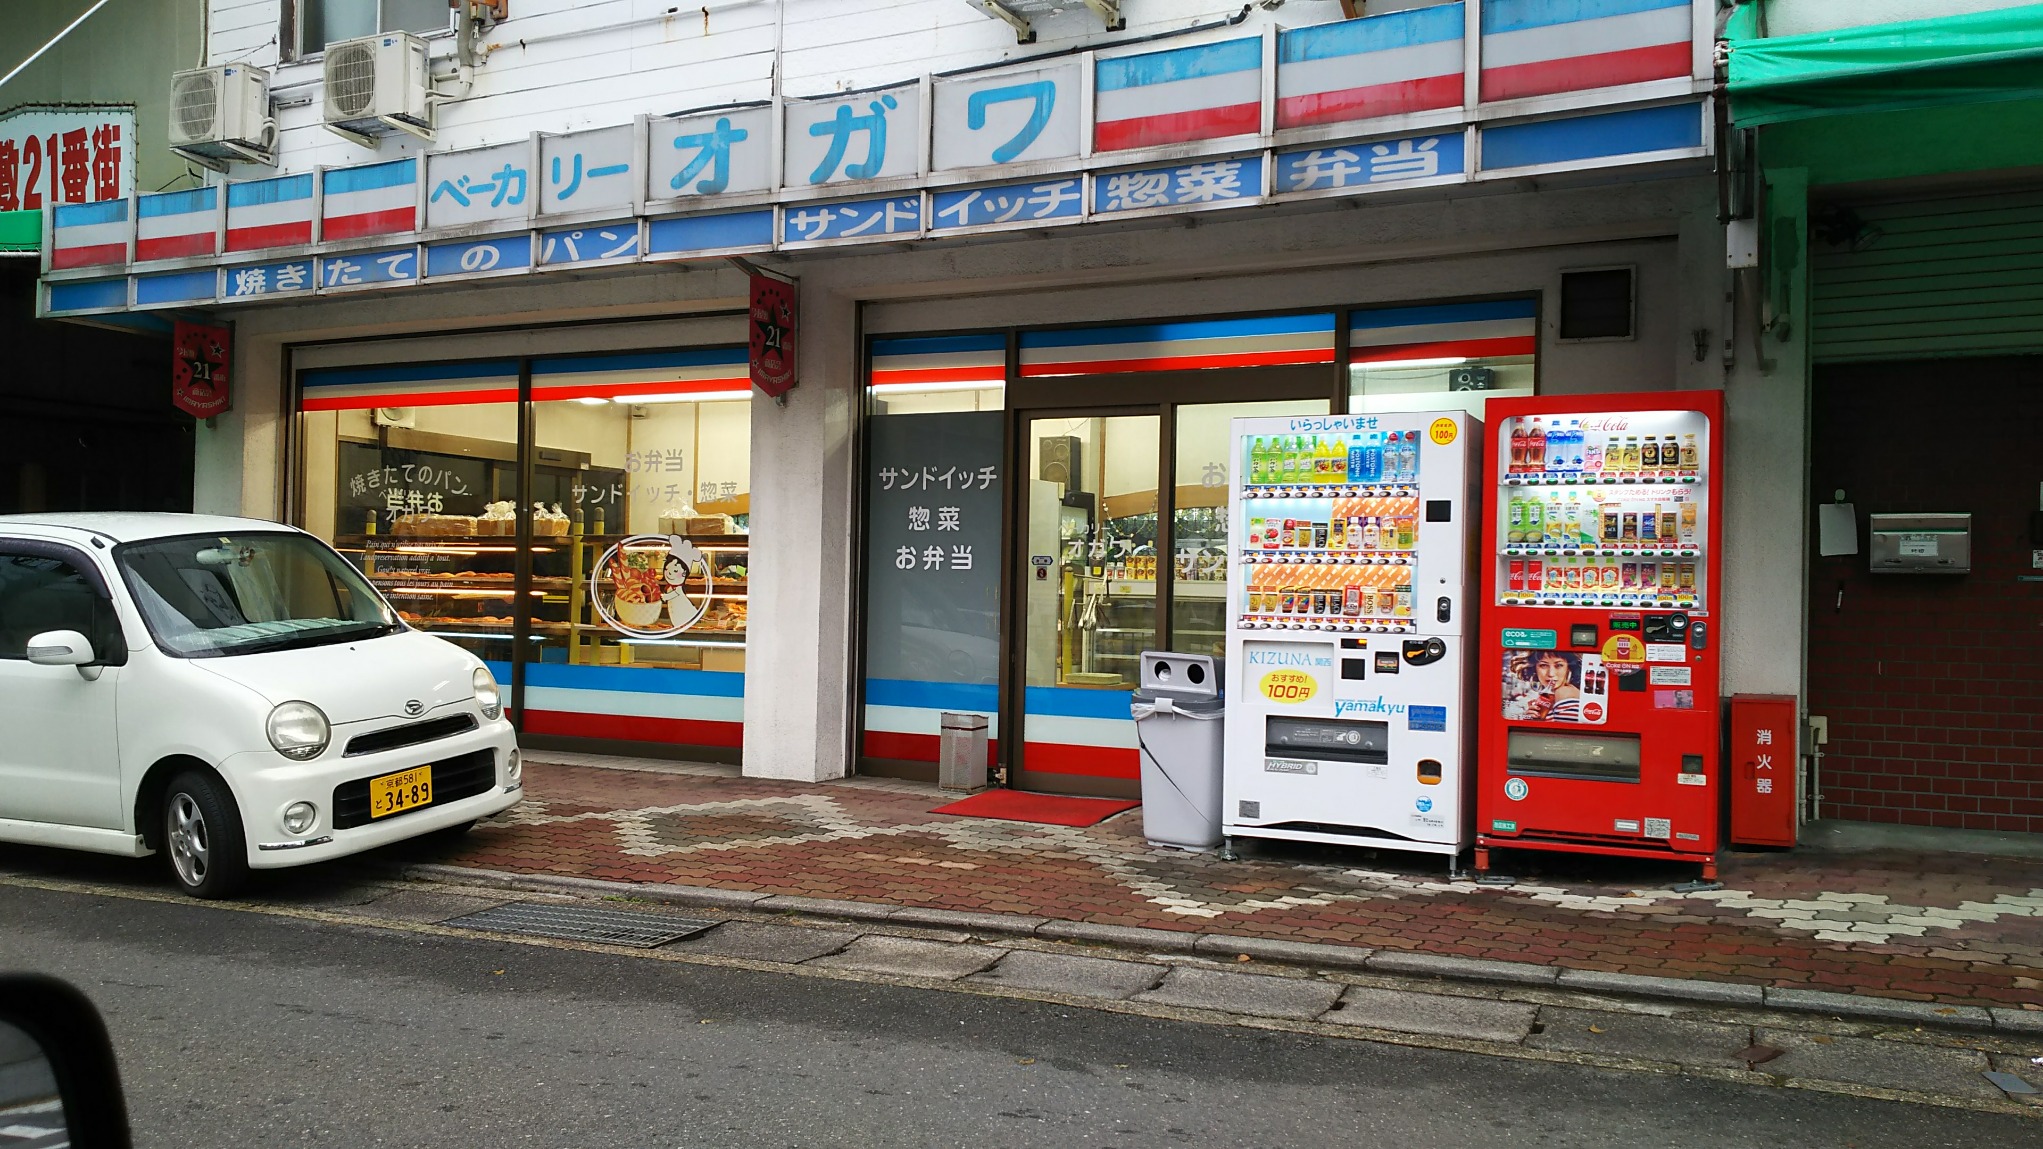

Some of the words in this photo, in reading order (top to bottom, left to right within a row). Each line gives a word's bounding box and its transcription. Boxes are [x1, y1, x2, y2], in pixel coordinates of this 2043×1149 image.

[430, 153, 630, 208] ベーカリー
[670, 79, 1056, 195] オガワ
[236, 231, 638, 296] 焼きたてのパン
[790, 180, 1080, 240] サンドイッチ
[1106, 161, 1242, 211] 惣菜
[1291, 138, 1439, 190] 弁当
[766, 325, 781, 348] 21
[193, 361, 211, 380] 21
[1290, 416, 1378, 431] いらっしゃいませ
[624, 449, 683, 473] お弁当
[350, 464, 467, 497] 焼きたてのパン
[879, 465, 997, 490] サンドイッチ
[908, 506, 960, 532] 惣菜
[895, 545, 972, 570] お弁当
[1249, 651, 1311, 666] KIZUNA
[1271, 674, 1307, 684] おすすめ!
[1268, 685, 1310, 699] 100円
[1335, 695, 1405, 718] yamakyu
[1267, 761, 1303, 770] HYBRID
[1756, 729, 1772, 793] 消火器
[385, 782, 429, 811] 34-89
